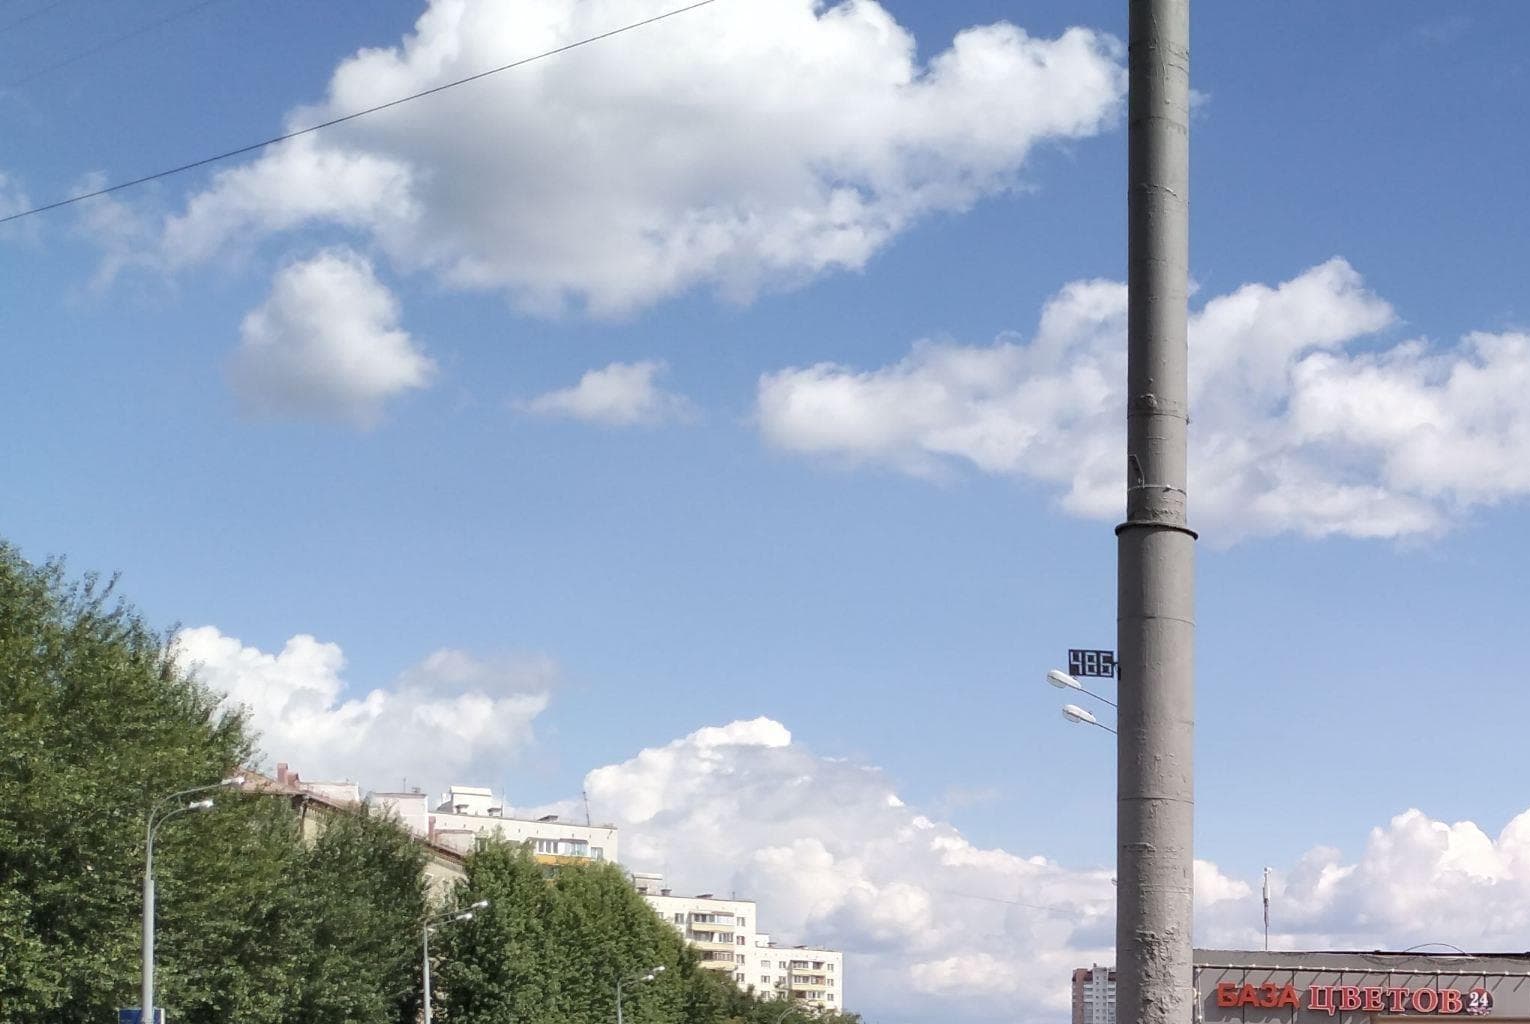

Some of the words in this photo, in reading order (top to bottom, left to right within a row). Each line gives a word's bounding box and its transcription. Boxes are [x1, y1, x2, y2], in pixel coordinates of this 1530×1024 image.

[1217, 982, 1299, 1008] БАЗА
[1308, 985, 1463, 1016] ЦВЕТОВ
[1469, 991, 1489, 1007] 24
